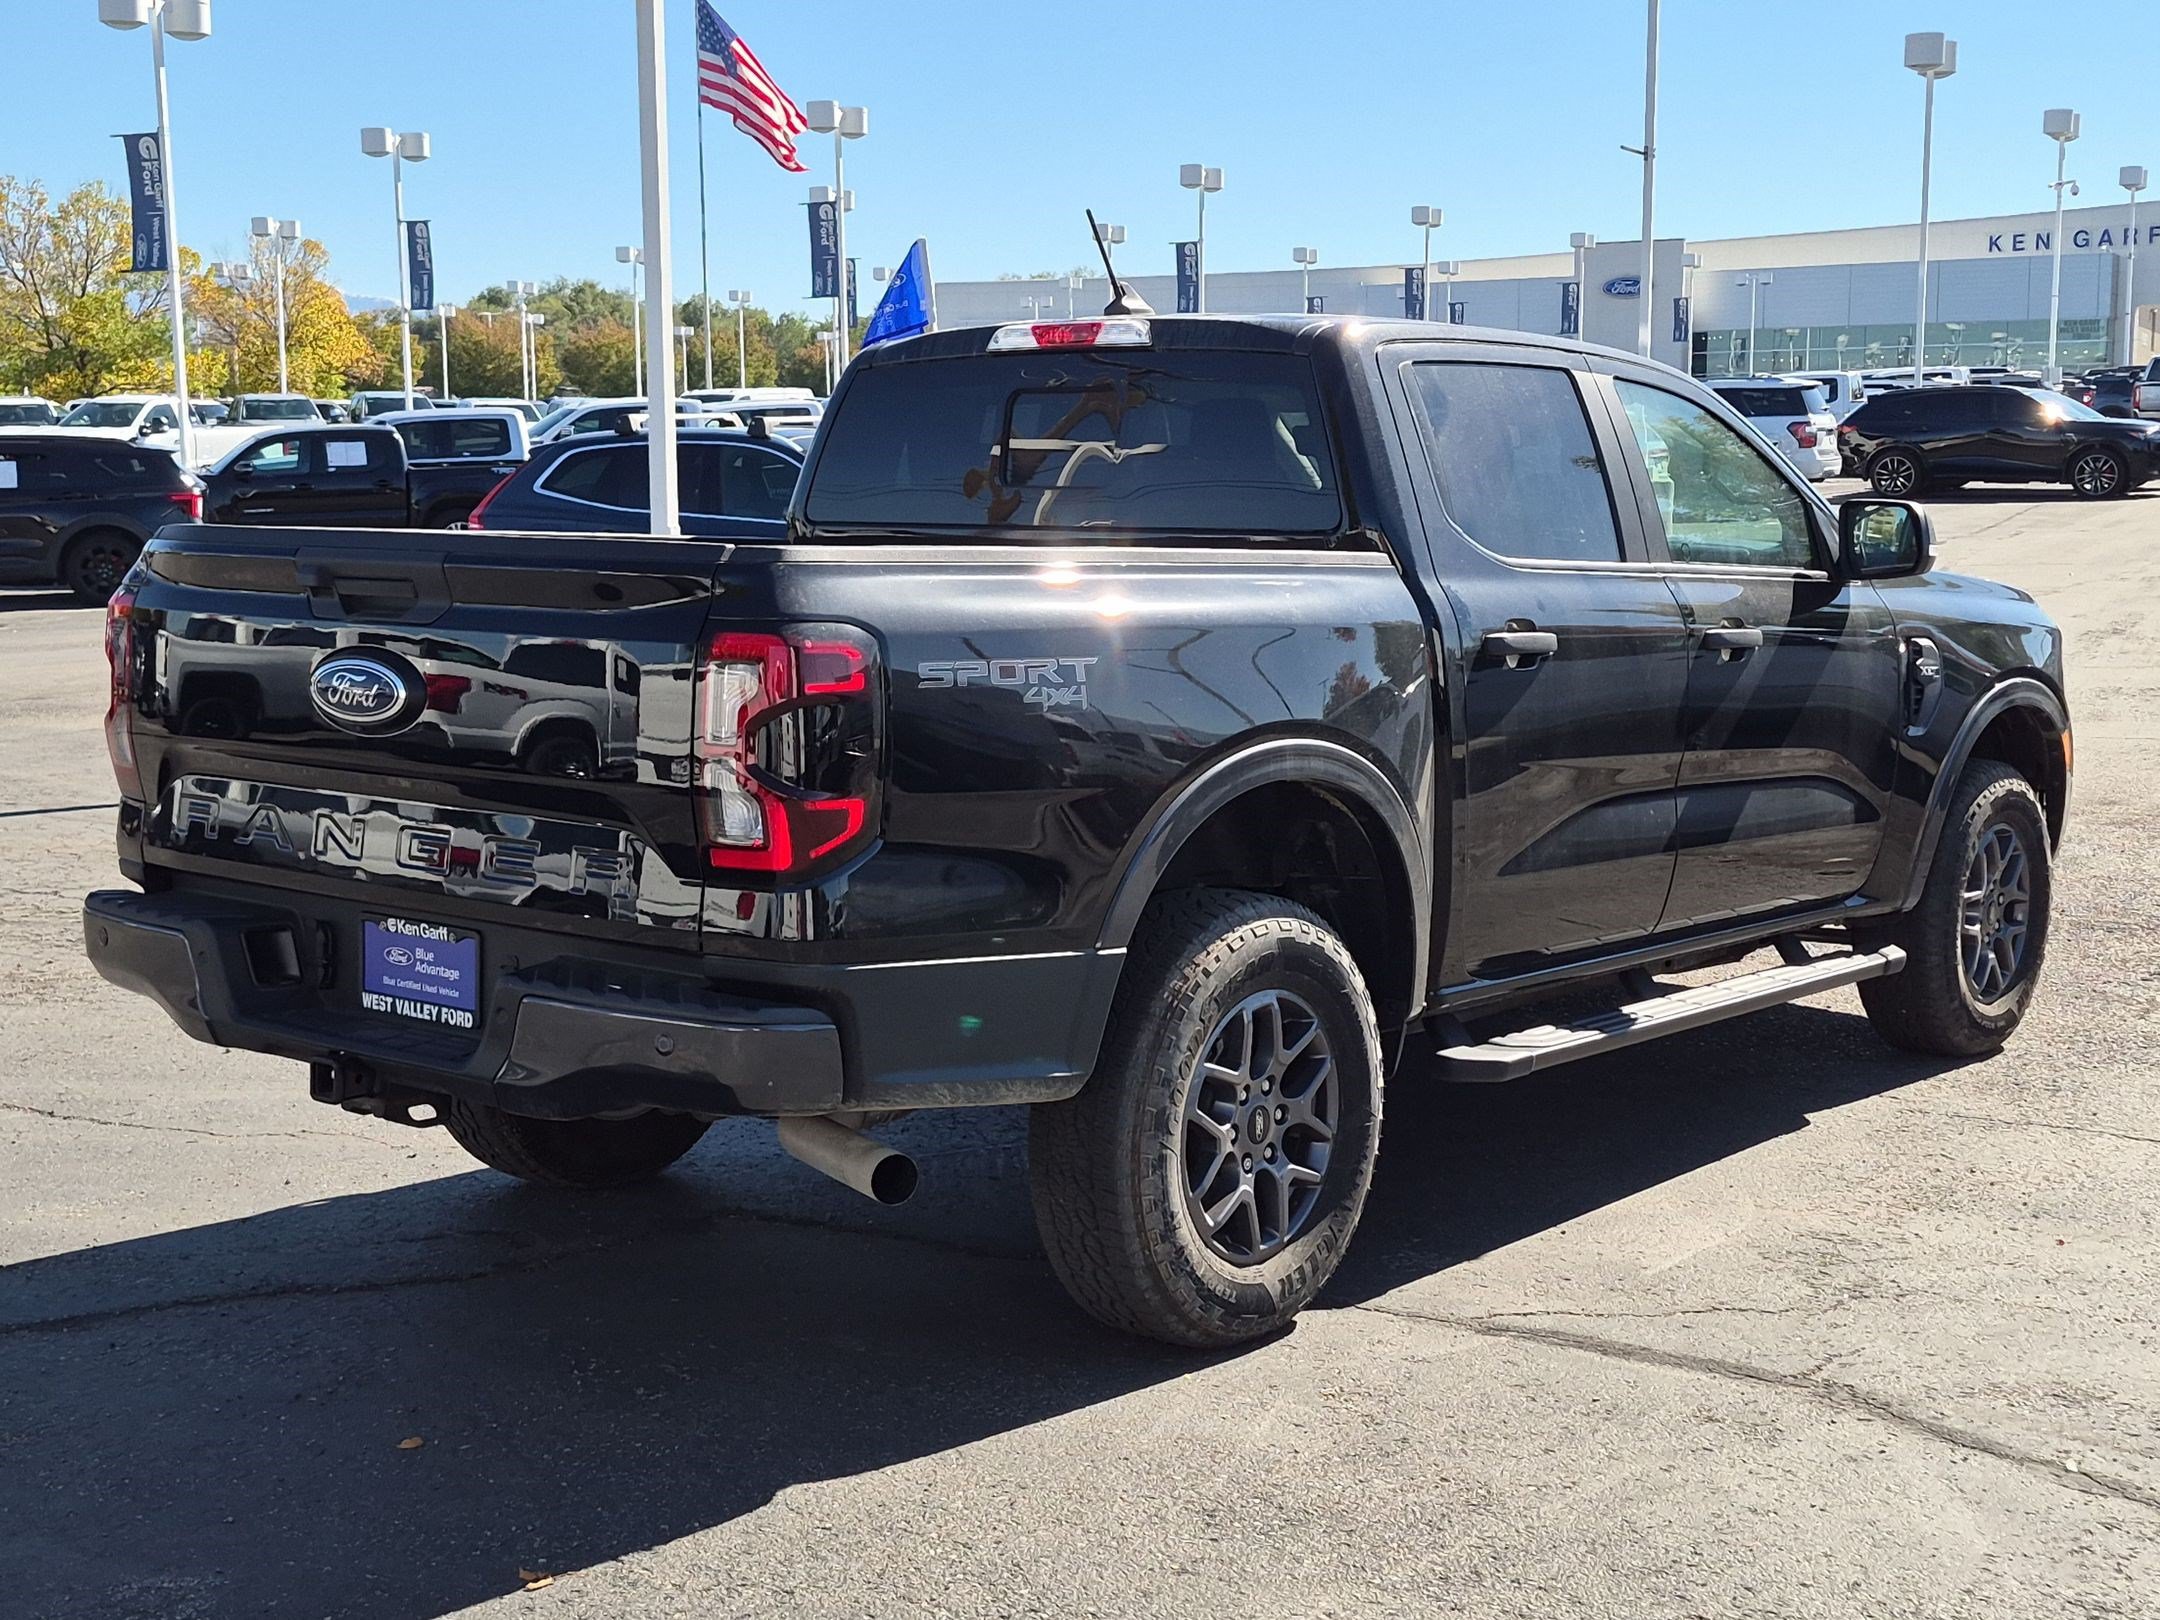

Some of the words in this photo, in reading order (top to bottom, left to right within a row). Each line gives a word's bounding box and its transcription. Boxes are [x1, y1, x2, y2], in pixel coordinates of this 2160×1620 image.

[141, 161, 154, 196] Ford
[151, 161, 160, 181] Ken
[152, 217, 160, 240] West
[820, 221, 829, 246] Ford
[1988, 232, 2051, 252] KEN
[150, 241, 161, 268] Valley
[917, 656, 1099, 689] SPORT
[327, 671, 380, 708] Ford
[172, 792, 634, 900] RANGER
[397, 919, 420, 937] Ken
[420, 922, 448, 942] Garff
[415, 947, 435, 962] Blue
[415, 961, 460, 981] Advantage
[396, 978, 421, 991] Certified
[422, 983, 438, 994] Used
[438, 986, 460, 998] Vehicle
[361, 991, 393, 1013] WEST
[395, 998, 439, 1022] VALLEY
[440, 1007, 473, 1029] FORD
